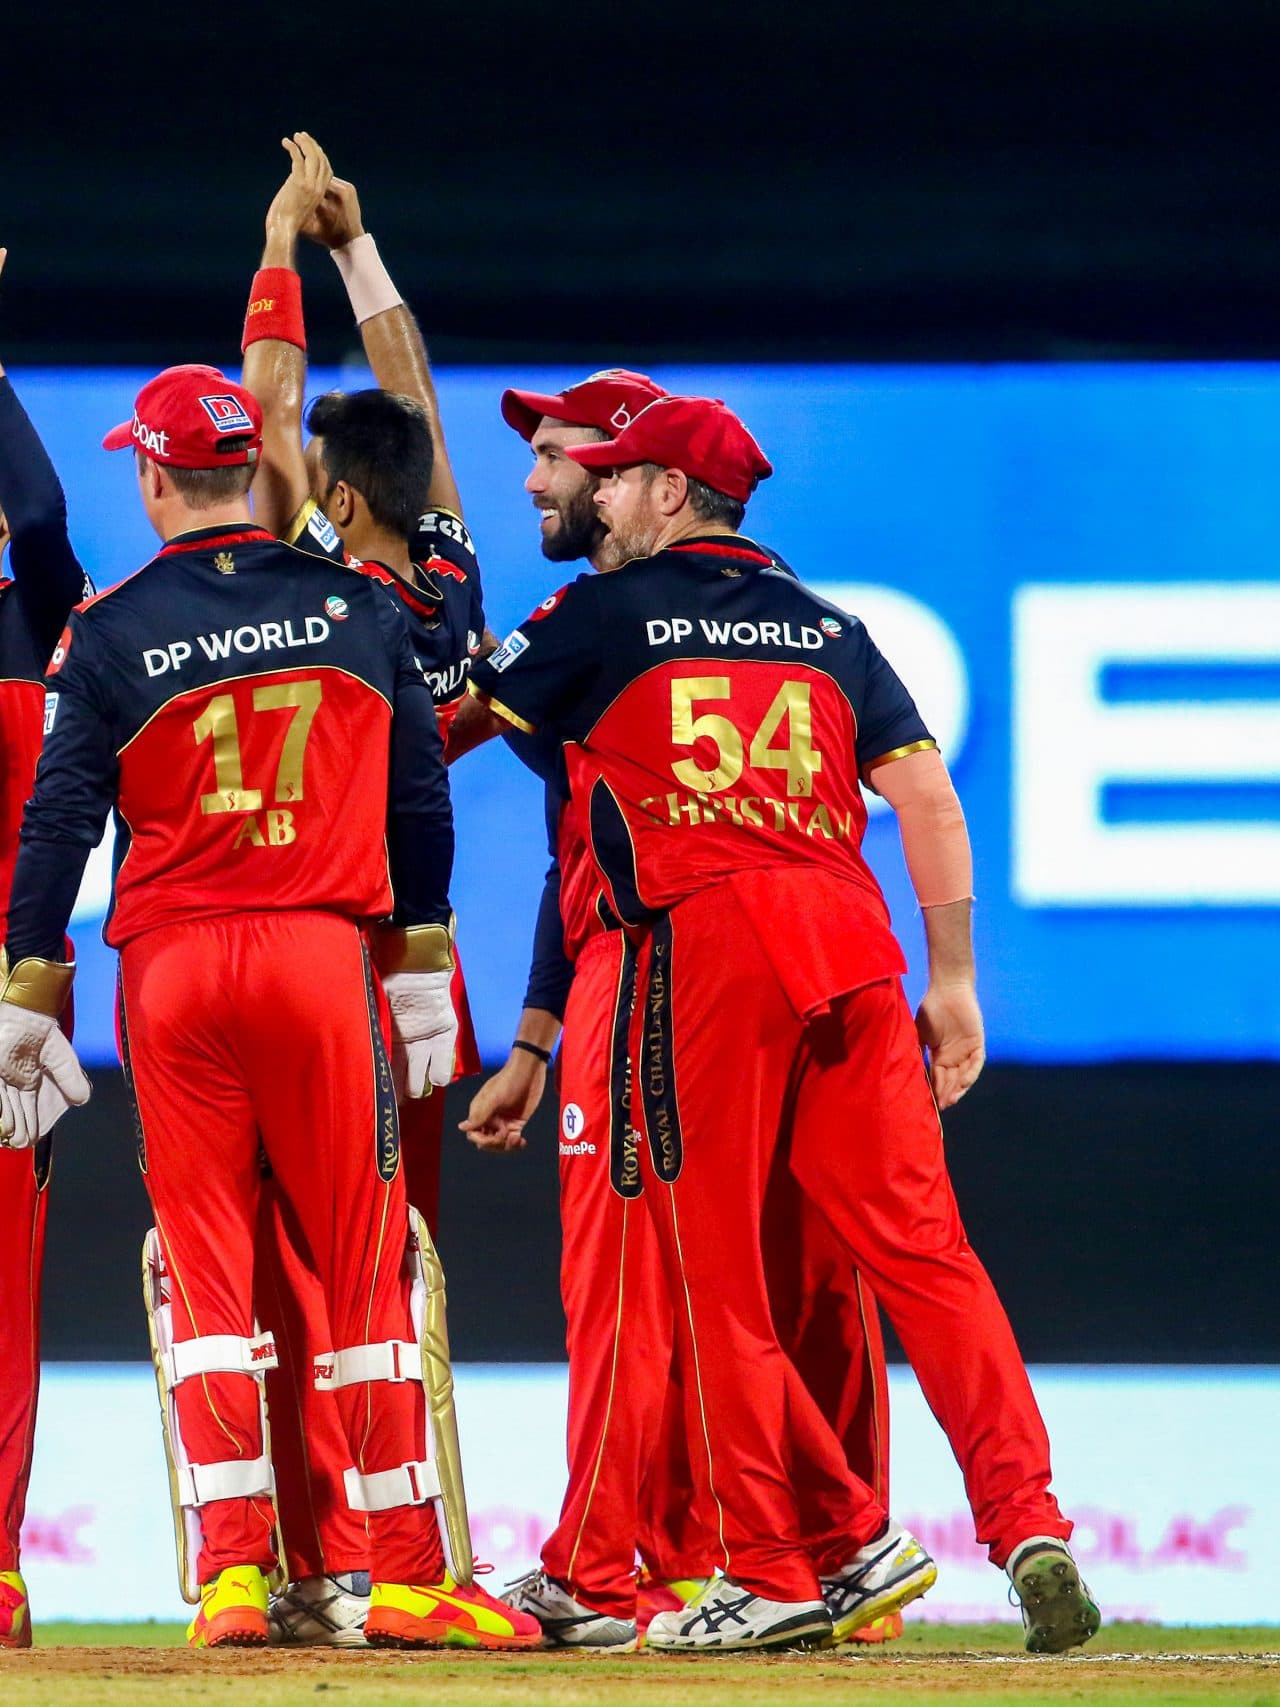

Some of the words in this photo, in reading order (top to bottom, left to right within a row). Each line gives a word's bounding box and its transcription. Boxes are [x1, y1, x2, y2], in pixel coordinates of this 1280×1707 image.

[142, 642, 192, 677] DP
[197, 616, 330, 662] WORLD
[646, 618, 692, 645] DP
[698, 619, 824, 650] WORLD
[192, 679, 322, 815] 17
[670, 676, 822, 797] 54
[232, 809, 297, 849] AB
[383, 1101, 398, 1174] ROYAL
